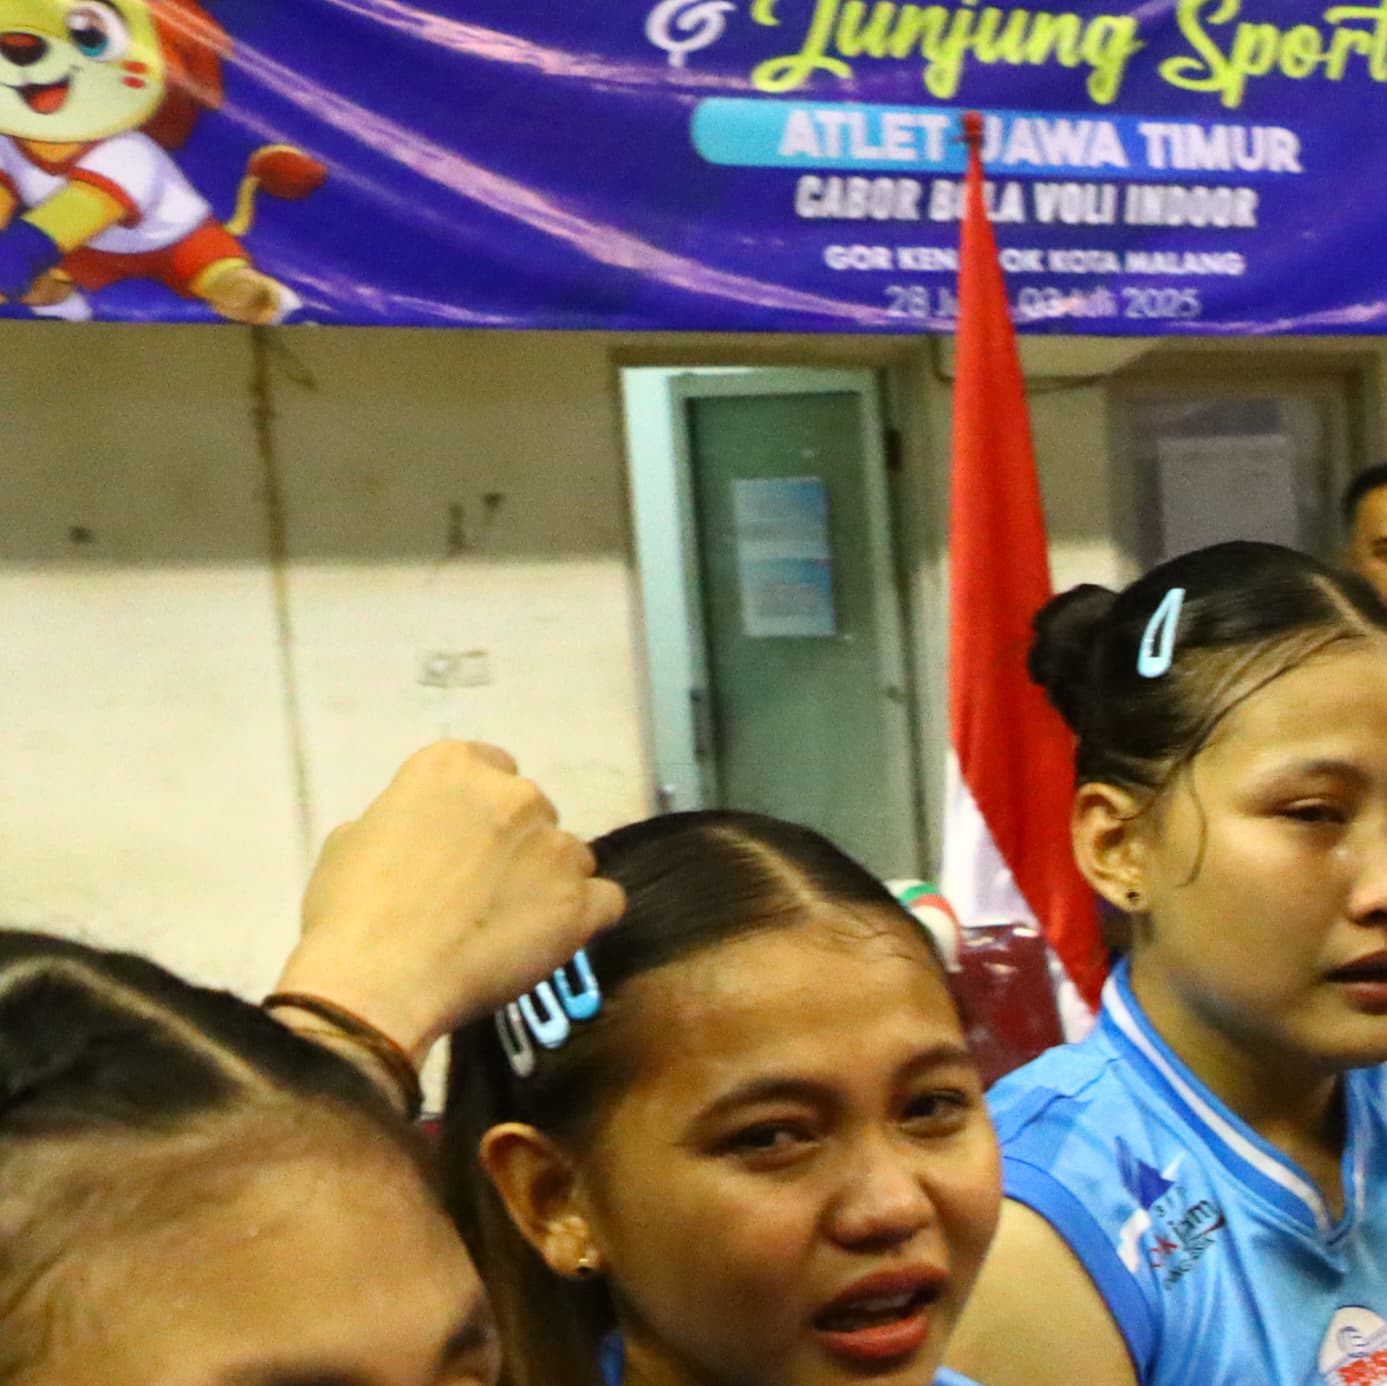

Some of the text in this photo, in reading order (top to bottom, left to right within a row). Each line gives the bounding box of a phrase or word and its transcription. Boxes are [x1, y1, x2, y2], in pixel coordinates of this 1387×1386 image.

[778, 109, 1304, 174] ATLET JAWA TIMUR
[795, 175, 922, 220] CABOR
[1033, 182, 1117, 224] VOLI
[1123, 185, 1259, 228] INDOOR
[823, 245, 893, 270] GOR
[1048, 249, 1120, 274] KOTA
[1124, 252, 1246, 276] MALANG
